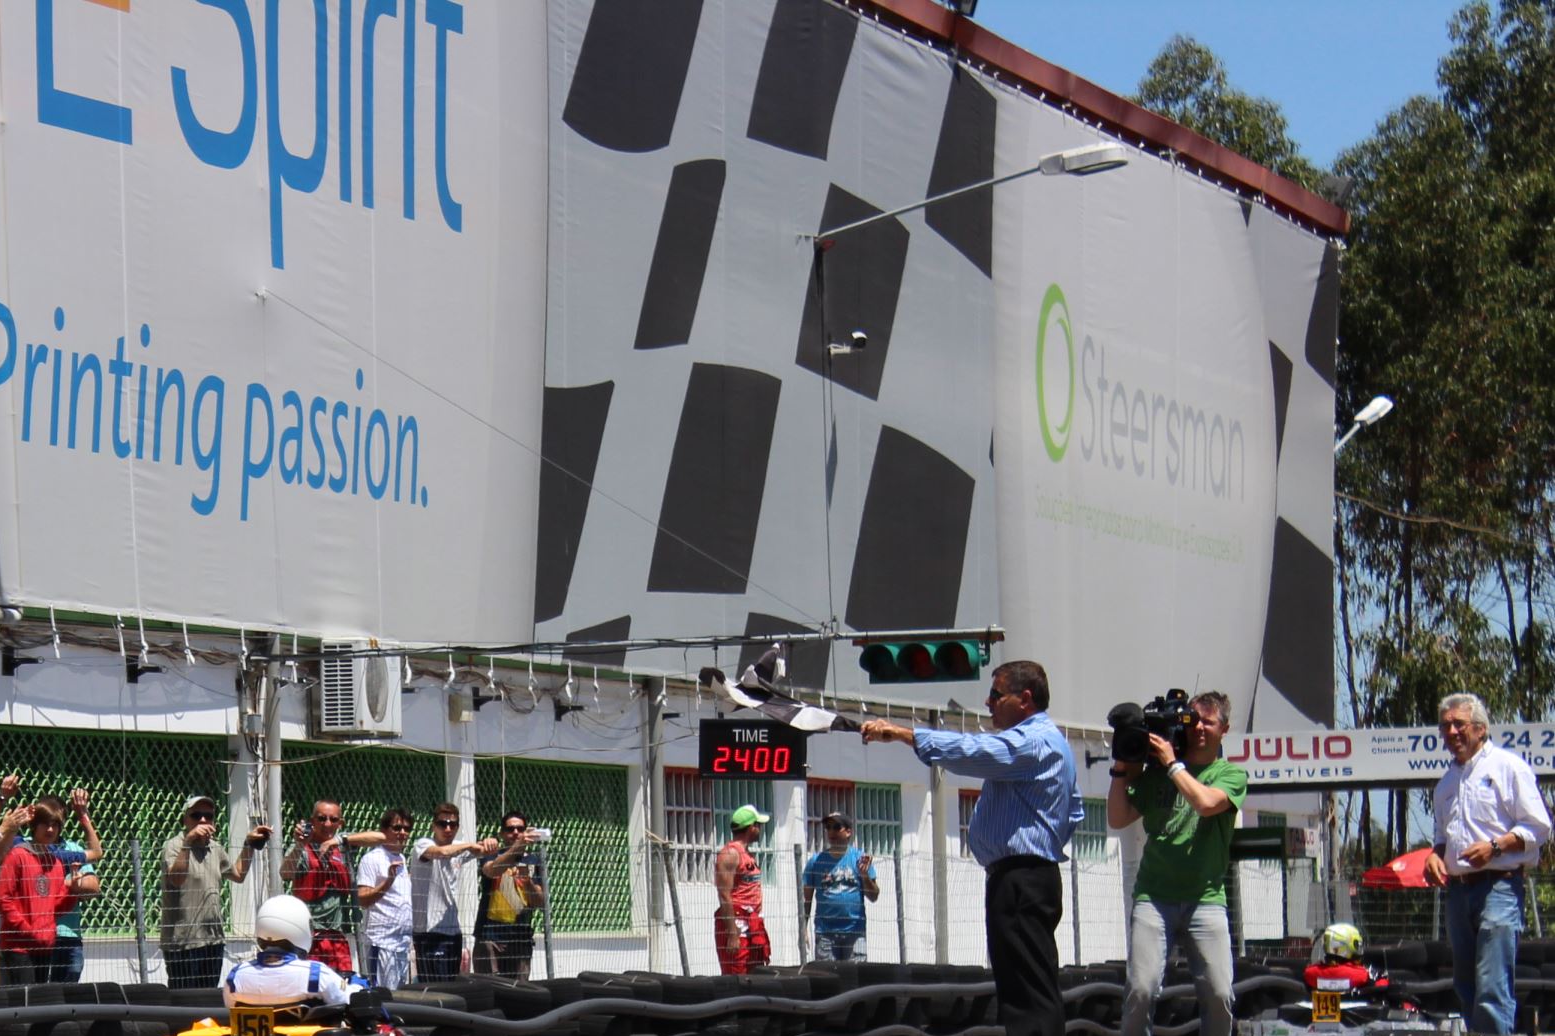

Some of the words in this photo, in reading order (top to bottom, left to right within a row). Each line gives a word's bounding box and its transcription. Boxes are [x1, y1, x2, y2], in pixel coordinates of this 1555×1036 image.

[1080, 334, 1244, 503] Steersman
[240, 368, 428, 521] passion.
[733, 729, 769, 743] TIME
[1501, 731, 1533, 748] 24
[713, 747, 791, 774] 2400
